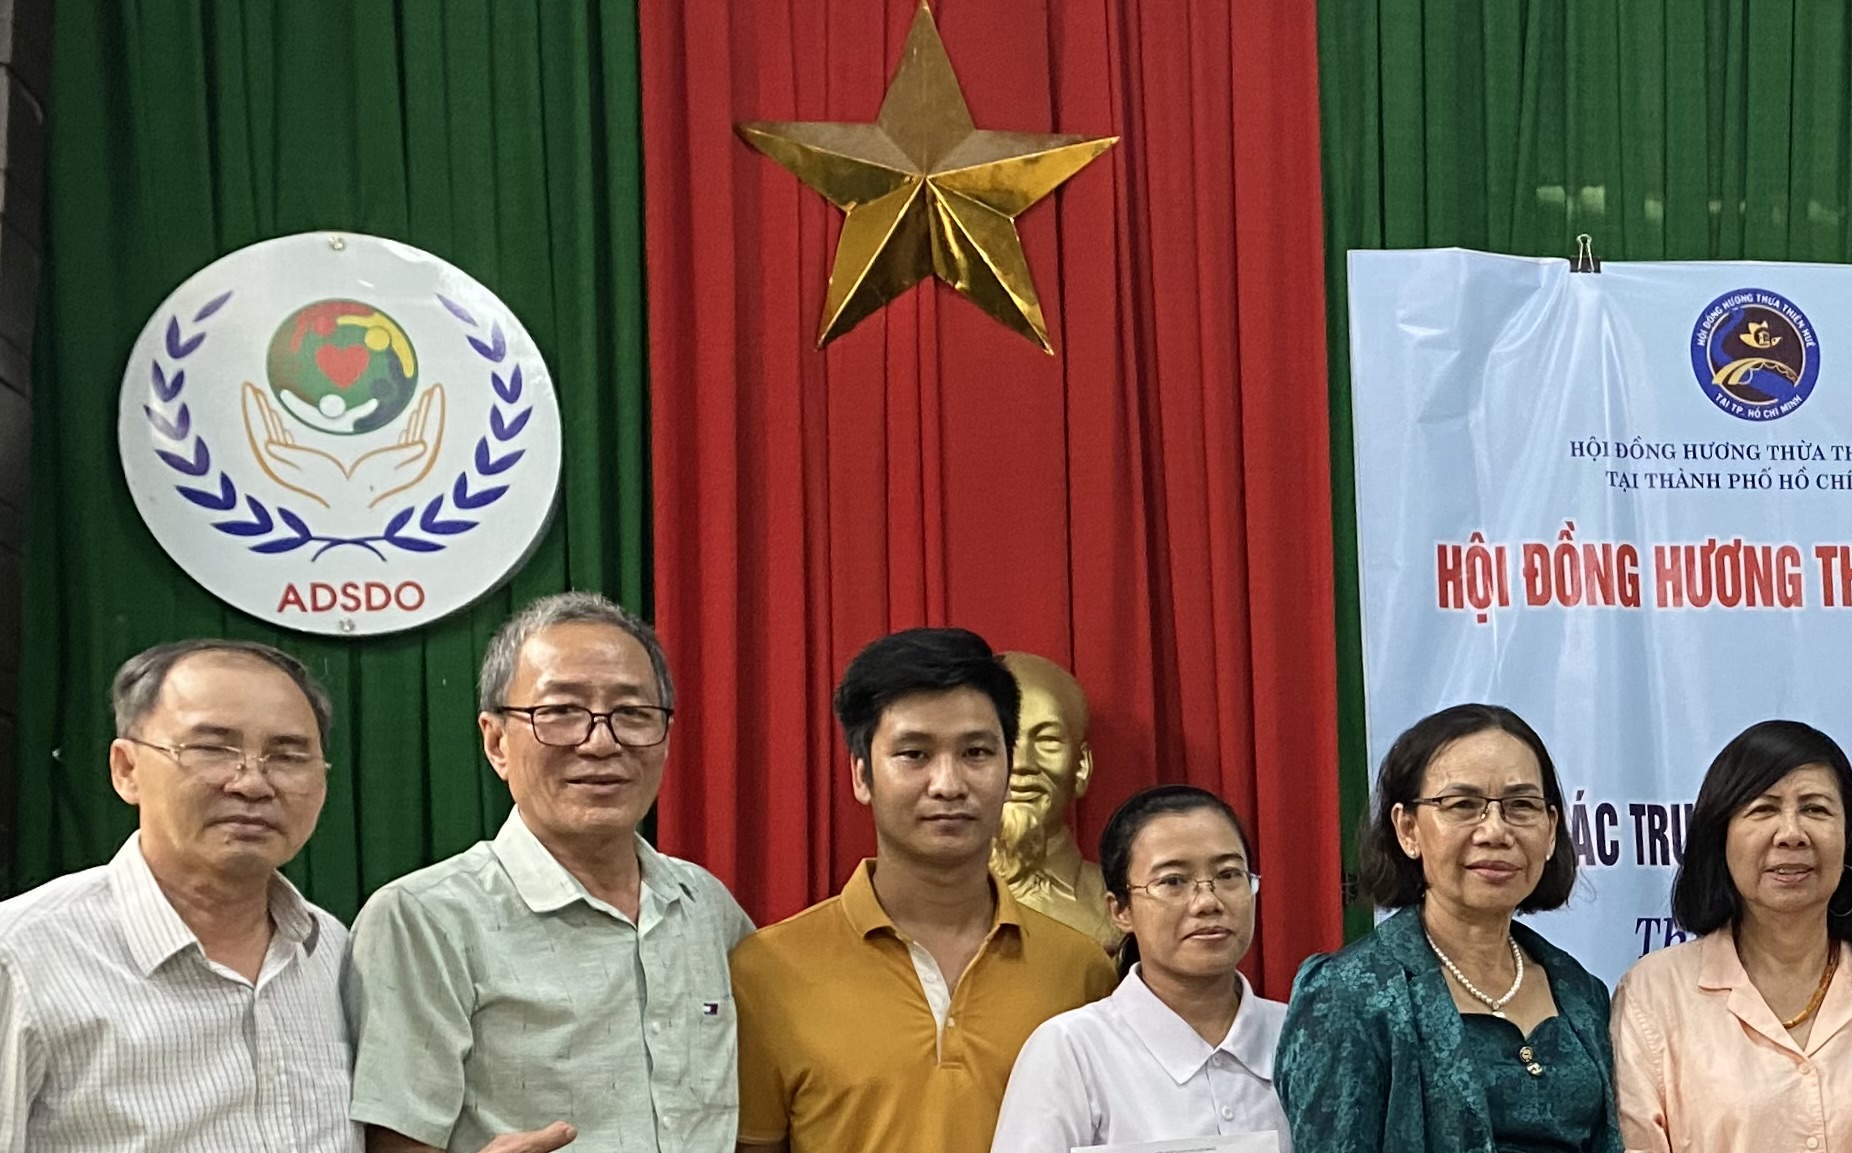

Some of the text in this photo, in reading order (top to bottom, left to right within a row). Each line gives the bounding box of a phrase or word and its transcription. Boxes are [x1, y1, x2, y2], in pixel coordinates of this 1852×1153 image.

[1781, 394, 1803, 414] MINH
[1570, 436, 1610, 463] HỘI
[1615, 436, 1676, 460] ĐỒNG
[1683, 443, 1761, 462] HƯƠNG
[1766, 441, 1826, 462] THỪA
[1605, 470, 1640, 493] TẠI
[1645, 468, 1721, 490] THÀNH
[1728, 467, 1772, 491] PHỐ
[1779, 467, 1810, 491] HỒ
[1816, 470, 1852, 490] CHÍ
[1436, 530, 1510, 624] HỘI
[1522, 520, 1641, 608] ĐỒNG
[1654, 537, 1805, 608] HƯƠNG
[276, 580, 425, 613] ADSDO
[1571, 789, 1620, 867] ÁC
